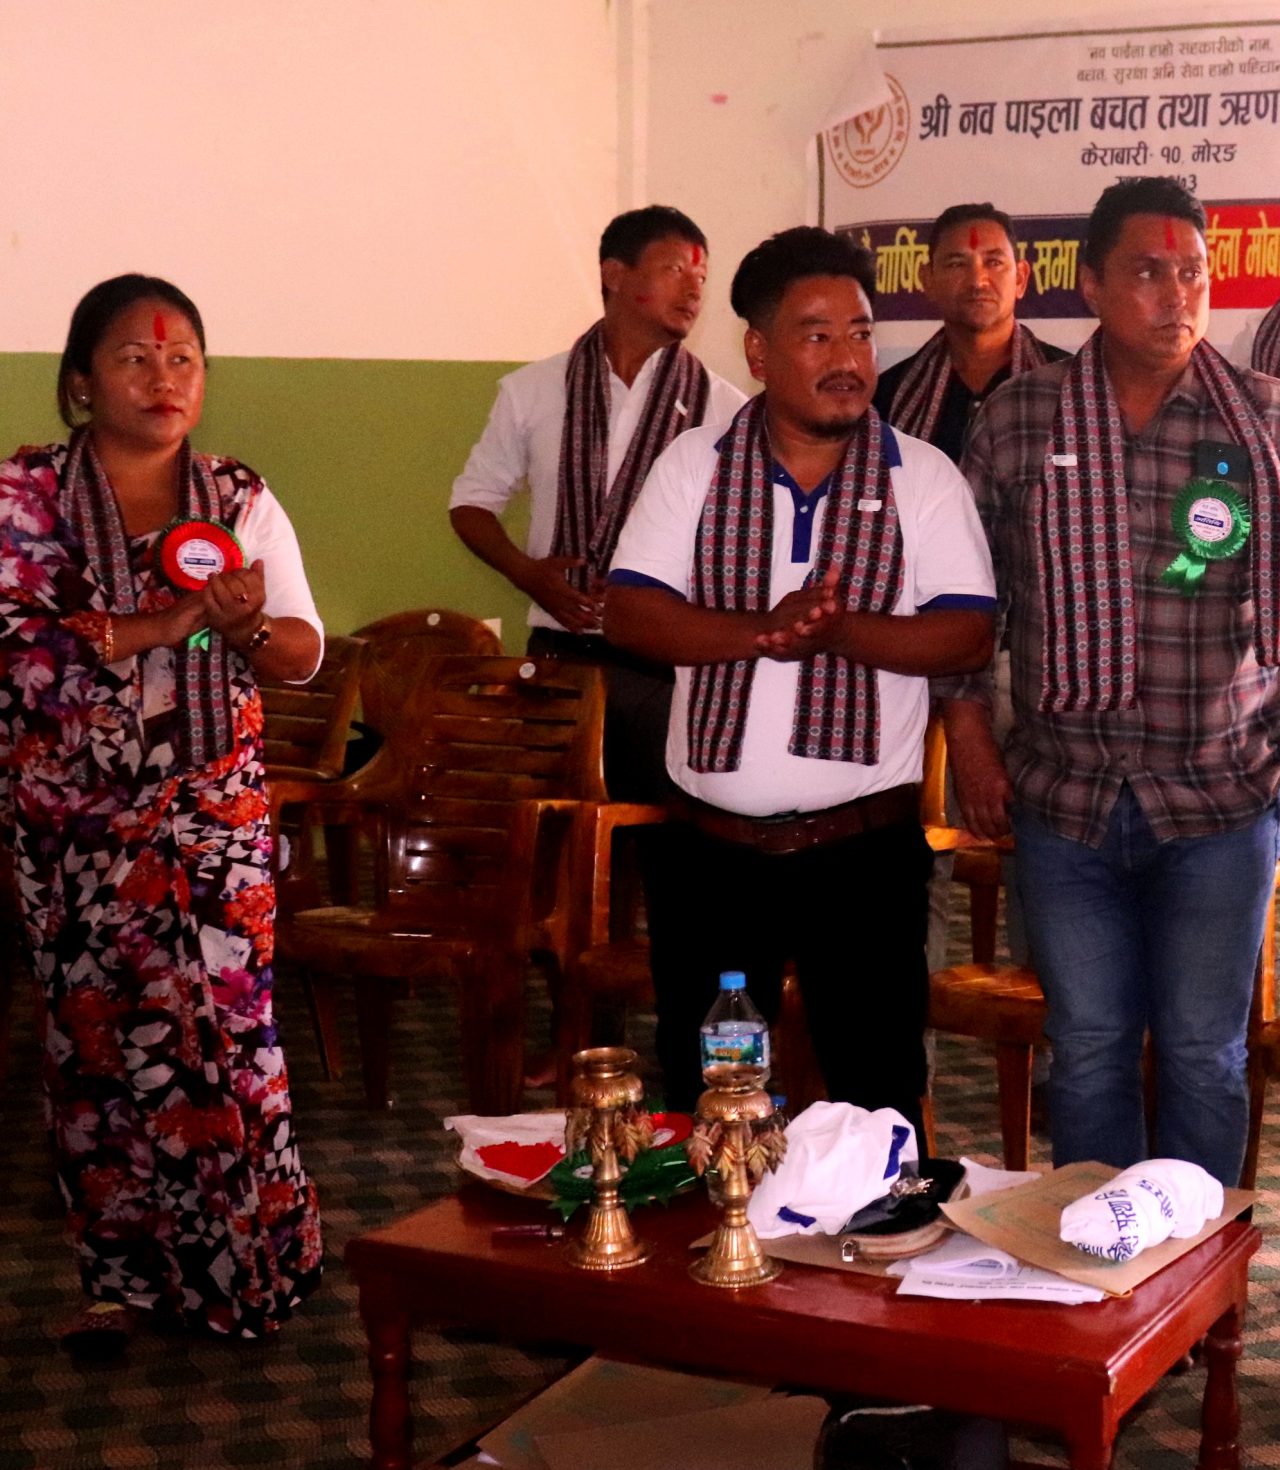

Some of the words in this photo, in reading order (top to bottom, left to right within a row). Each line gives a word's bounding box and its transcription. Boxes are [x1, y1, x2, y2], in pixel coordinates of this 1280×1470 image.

[1178, 36, 1244, 55] सहकारीको
[1113, 66, 1147, 85] सुरक्षा
[1152, 62, 1175, 80] अनि
[1181, 61, 1204, 79] सेवा
[919, 93, 951, 140] श्री
[959, 101, 997, 136] नव
[1005, 96, 1082, 138] पाइला
[1090, 95, 1150, 131] बचत
[1157, 93, 1211, 130] तथा
[1219, 88, 1280, 126] ऋण
[1191, 138, 1237, 163] मोरङ
[1033, 240, 1080, 295] सभा
